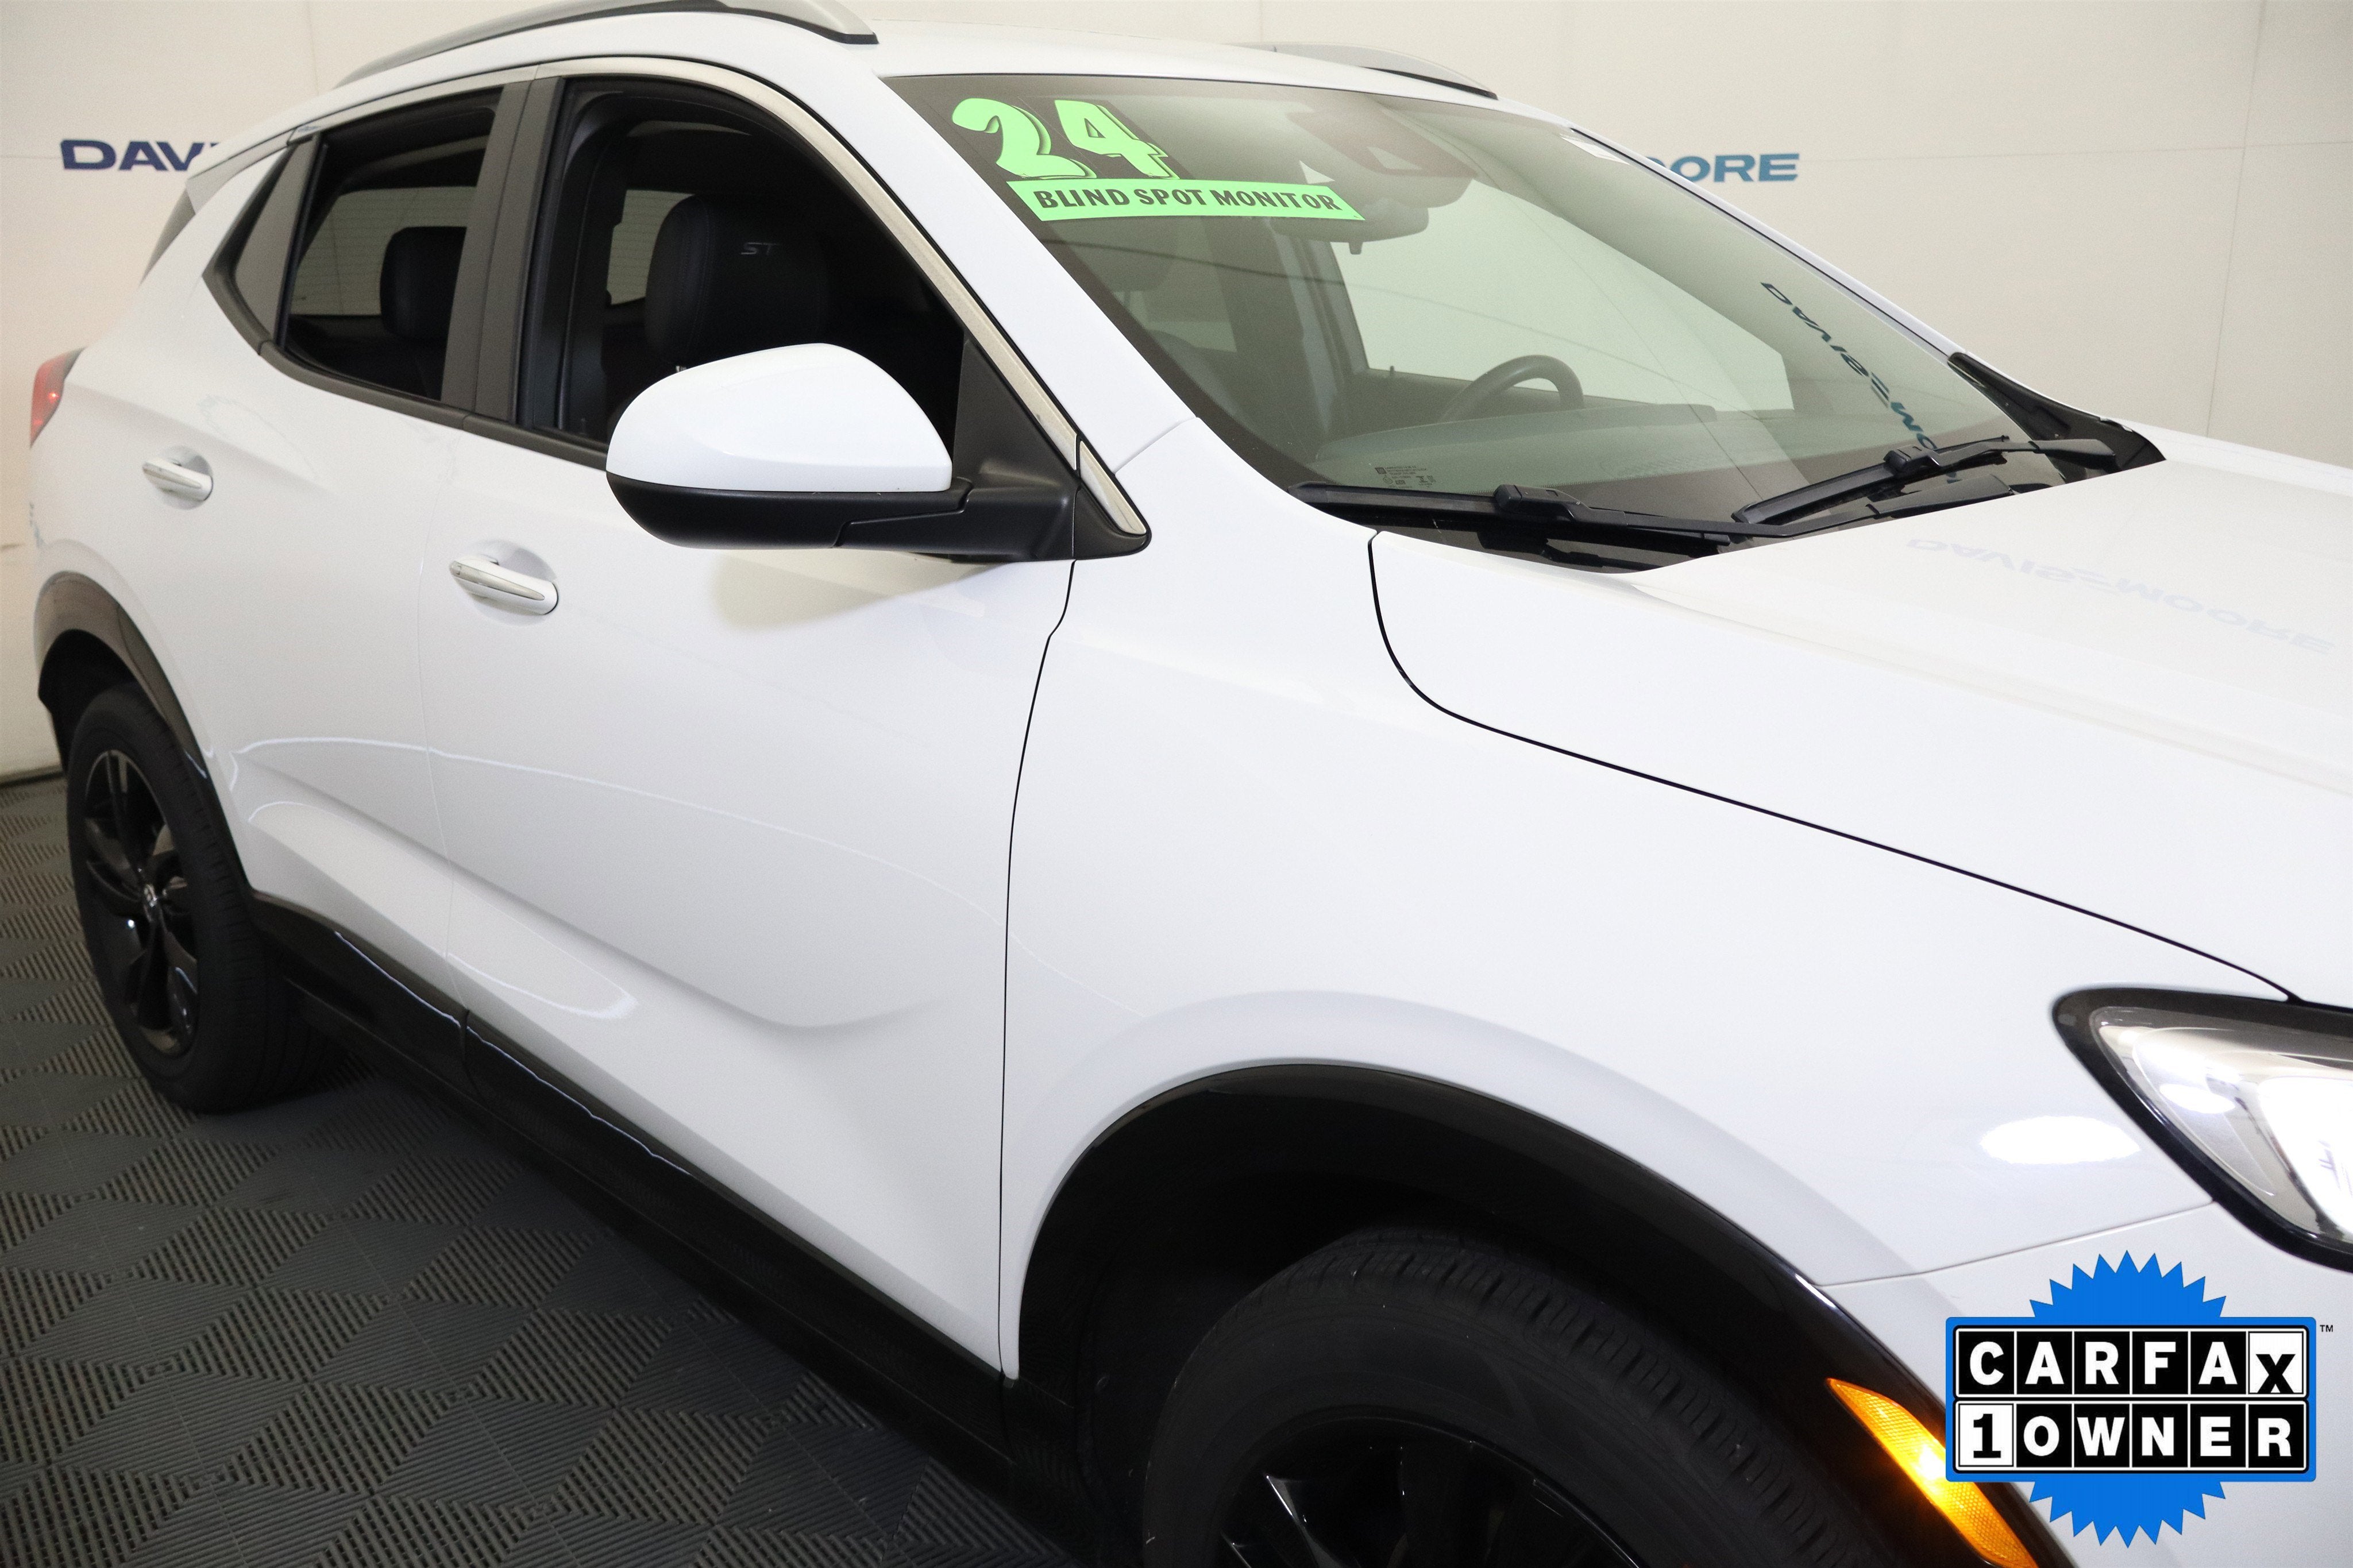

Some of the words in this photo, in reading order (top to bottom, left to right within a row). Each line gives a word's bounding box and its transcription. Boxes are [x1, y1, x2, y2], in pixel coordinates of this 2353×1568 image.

[951, 98, 1181, 180] 24
[60, 140, 219, 171] DAV
[1033, 190, 1131, 209] BLIND
[1137, 188, 1204, 206] SPOT
[1213, 190, 1342, 211] MONITOR
[740, 241, 780, 255] ST
